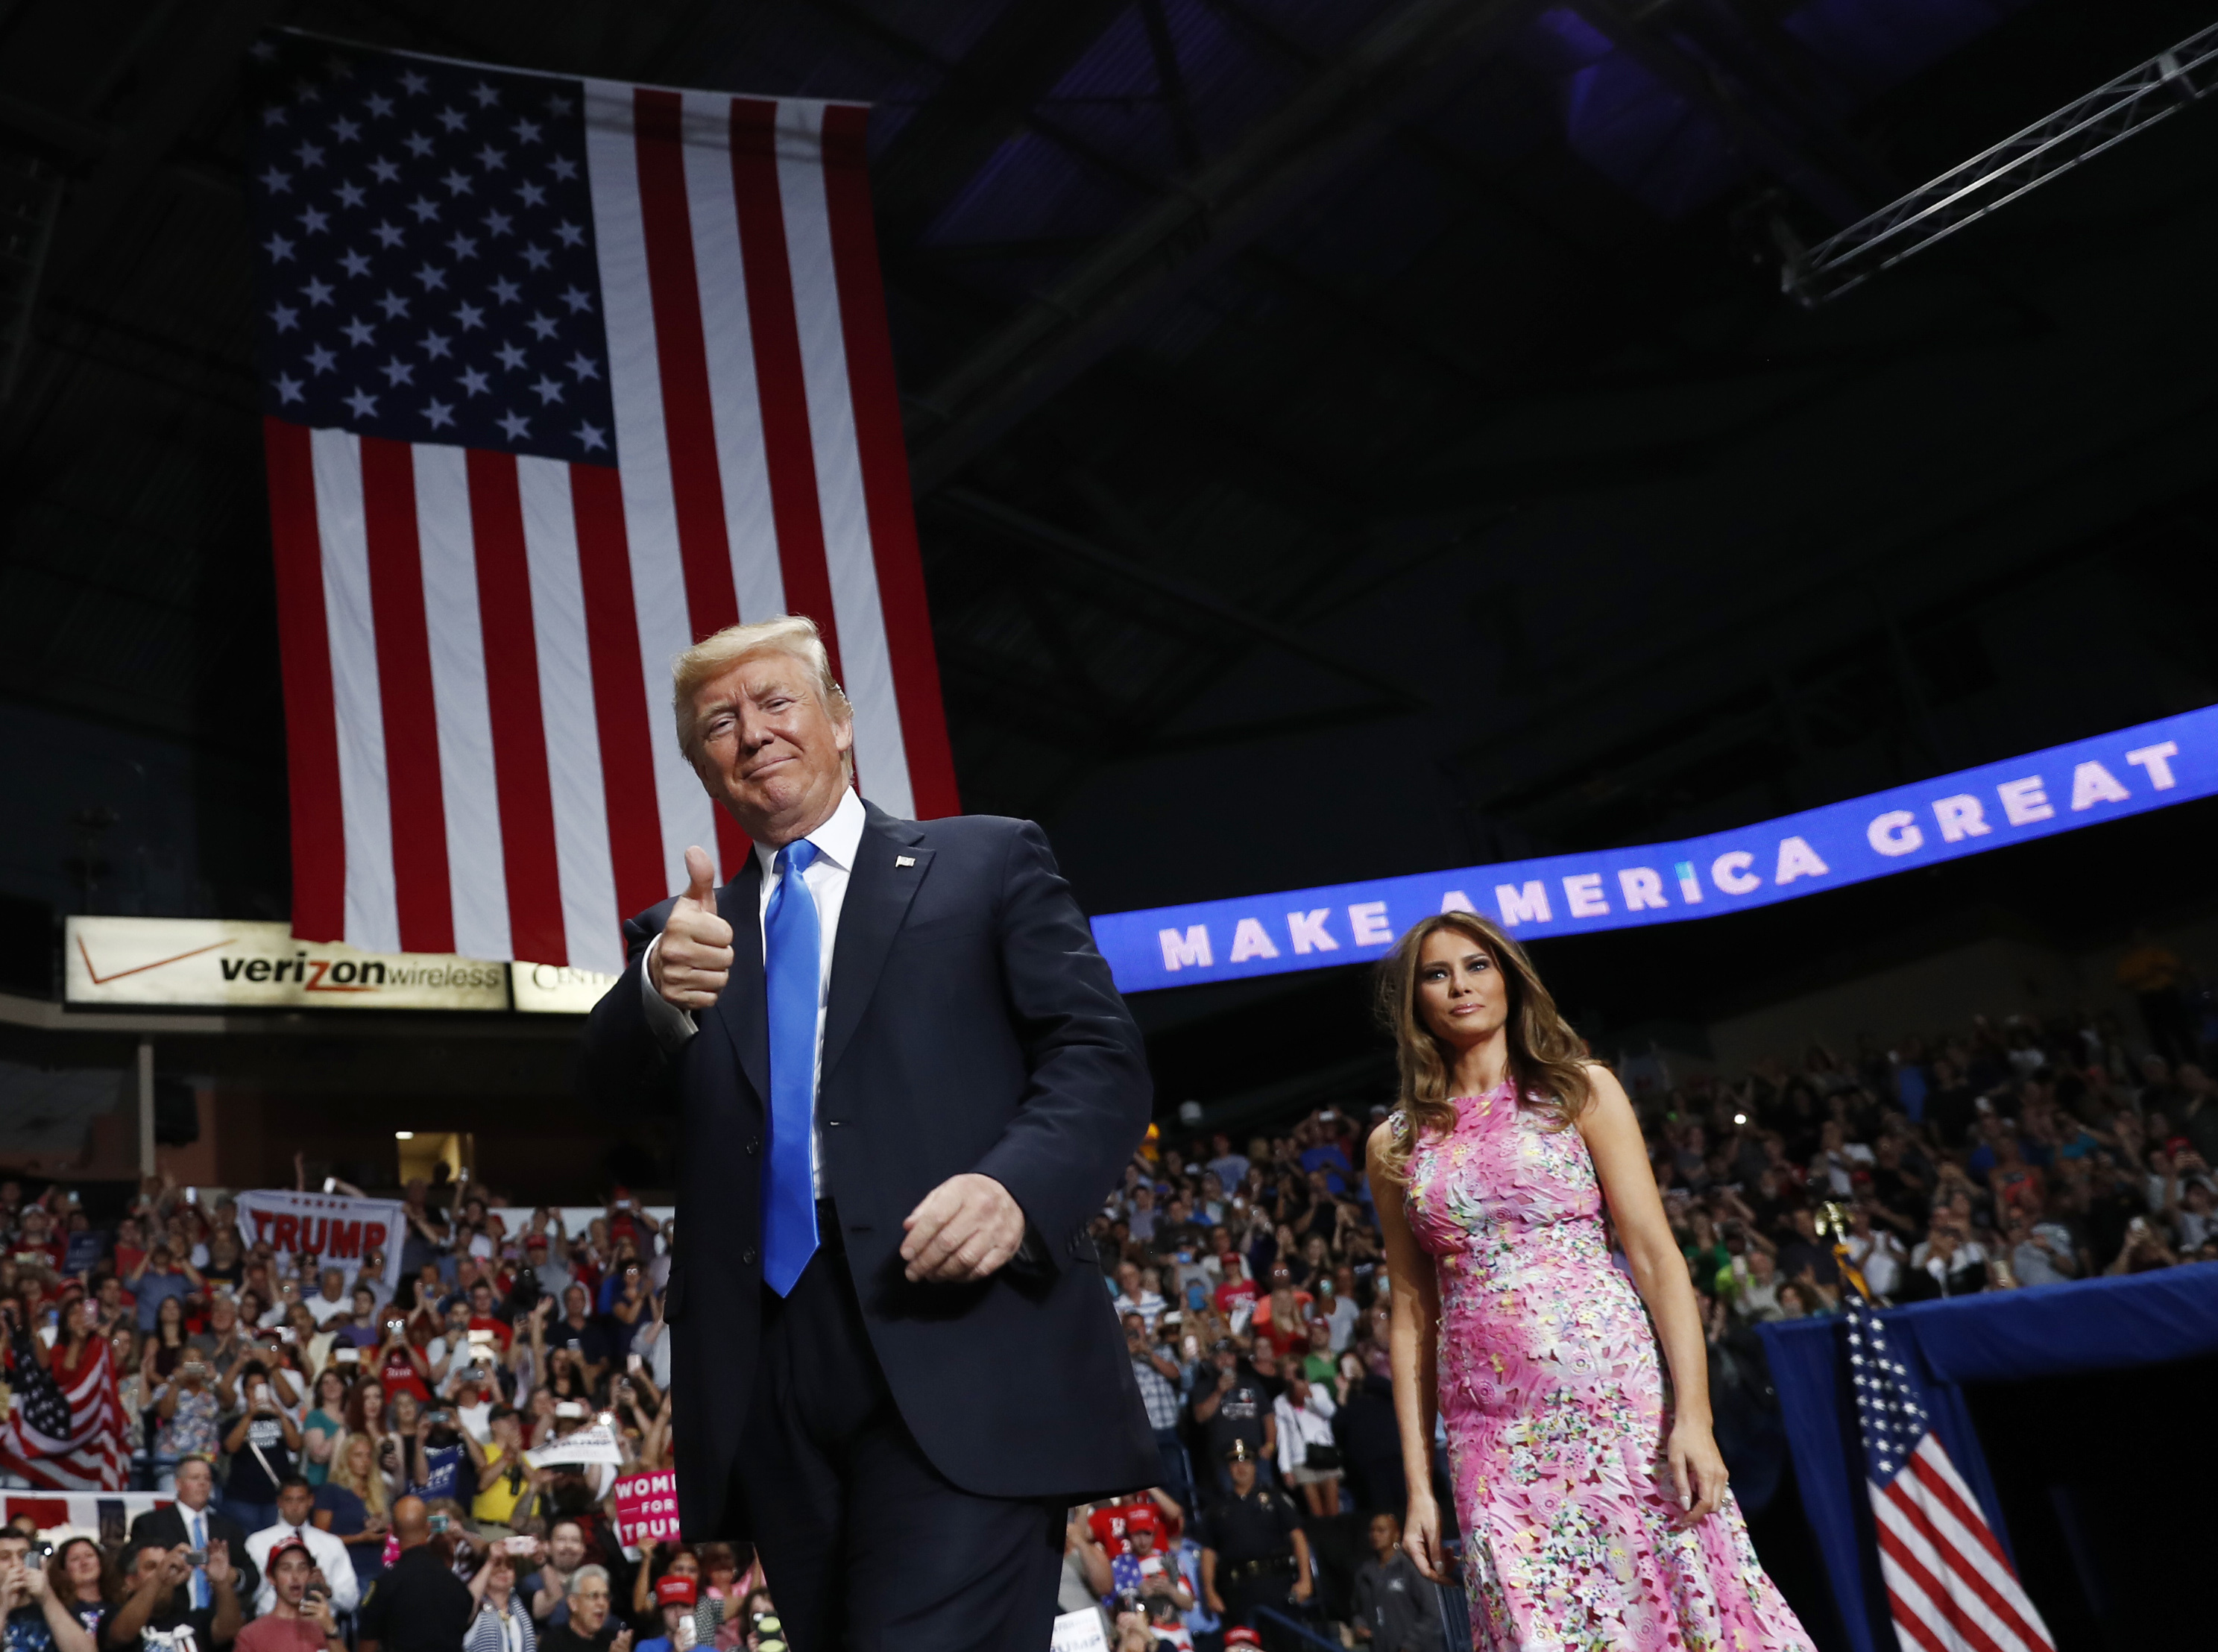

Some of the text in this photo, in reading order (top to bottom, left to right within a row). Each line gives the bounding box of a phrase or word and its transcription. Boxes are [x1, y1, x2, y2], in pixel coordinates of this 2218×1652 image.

[1159, 901, 1393, 971] MAKE
[1867, 740, 2178, 857] GREAT
[251, 1208, 386, 1258] TRUMP
[641, 1498, 675, 1515] FOR
